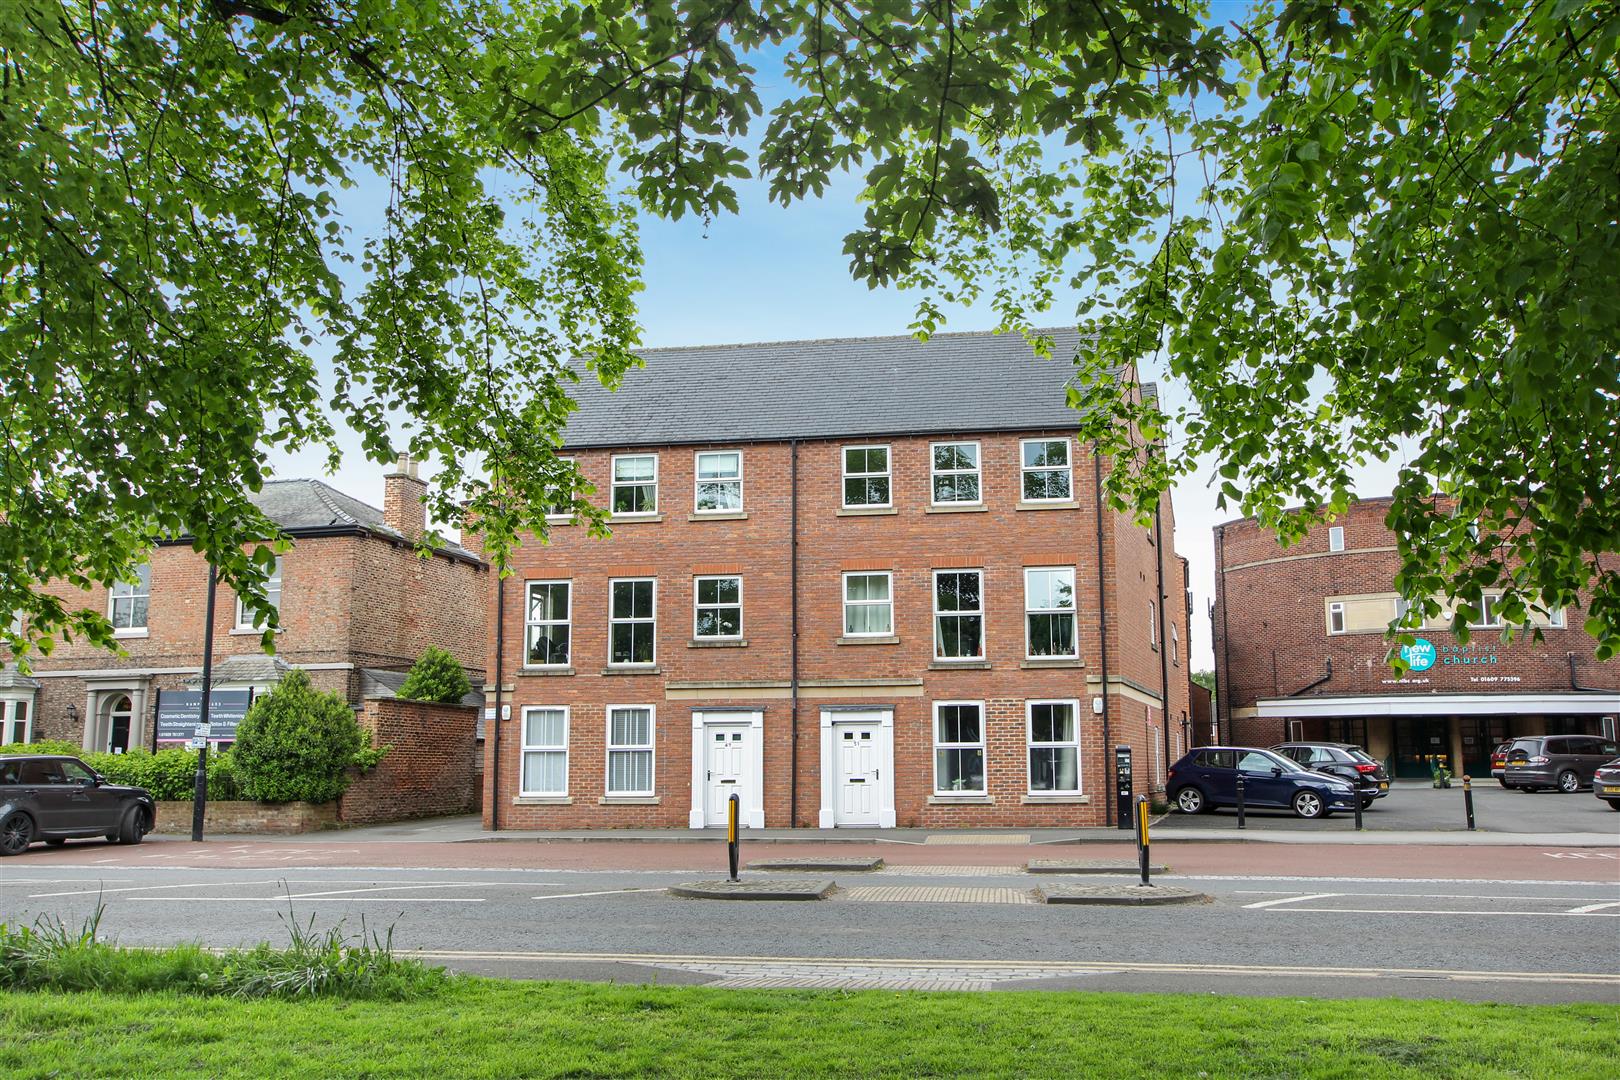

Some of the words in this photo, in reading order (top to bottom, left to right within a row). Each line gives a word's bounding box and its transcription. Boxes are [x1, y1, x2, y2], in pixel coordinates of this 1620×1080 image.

[1404, 643, 1431, 653] new
[1442, 645, 1497, 654] baptist
[1409, 655, 1428, 667] life
[1443, 655, 1498, 665] church
